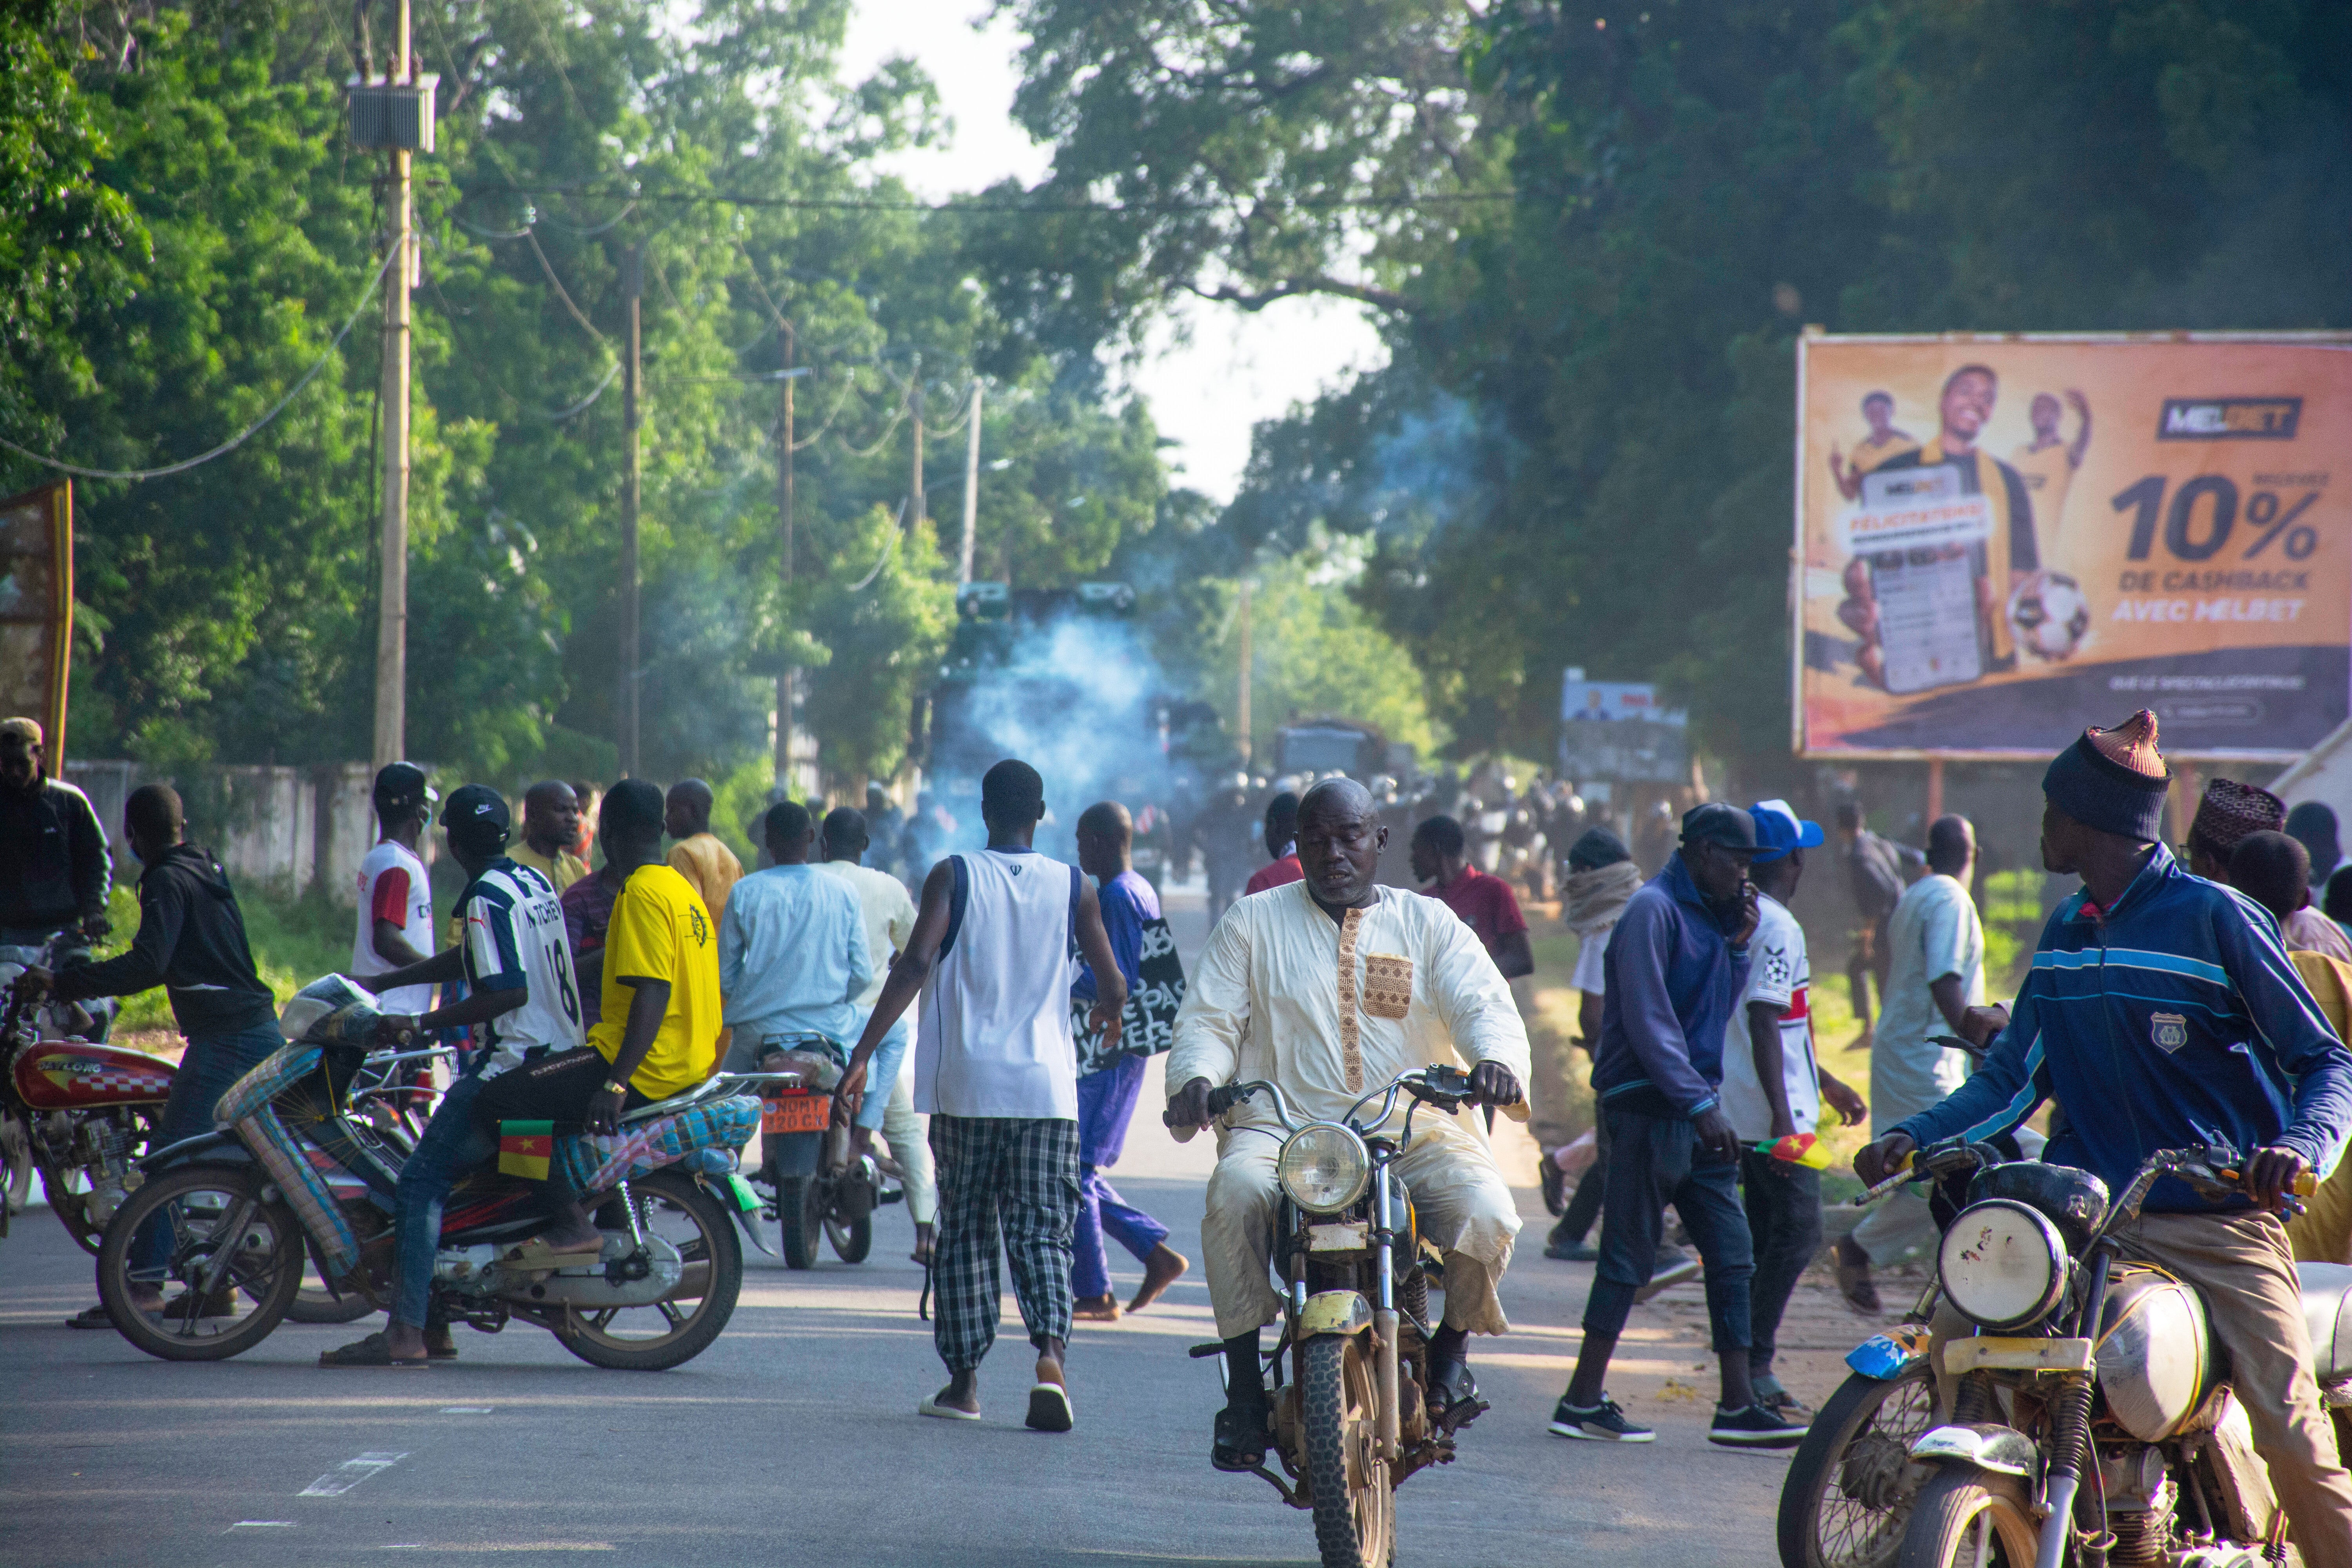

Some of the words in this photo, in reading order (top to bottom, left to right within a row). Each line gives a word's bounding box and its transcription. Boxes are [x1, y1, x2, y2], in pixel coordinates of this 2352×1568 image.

[2110, 475, 2321, 561] 10%
[2118, 570, 2157, 592] DE
[2162, 569, 2311, 592] CASHBACK
[2111, 598, 2189, 621] AVEC
[2193, 597, 2305, 622] MELBET
[544, 938, 579, 1027] 18
